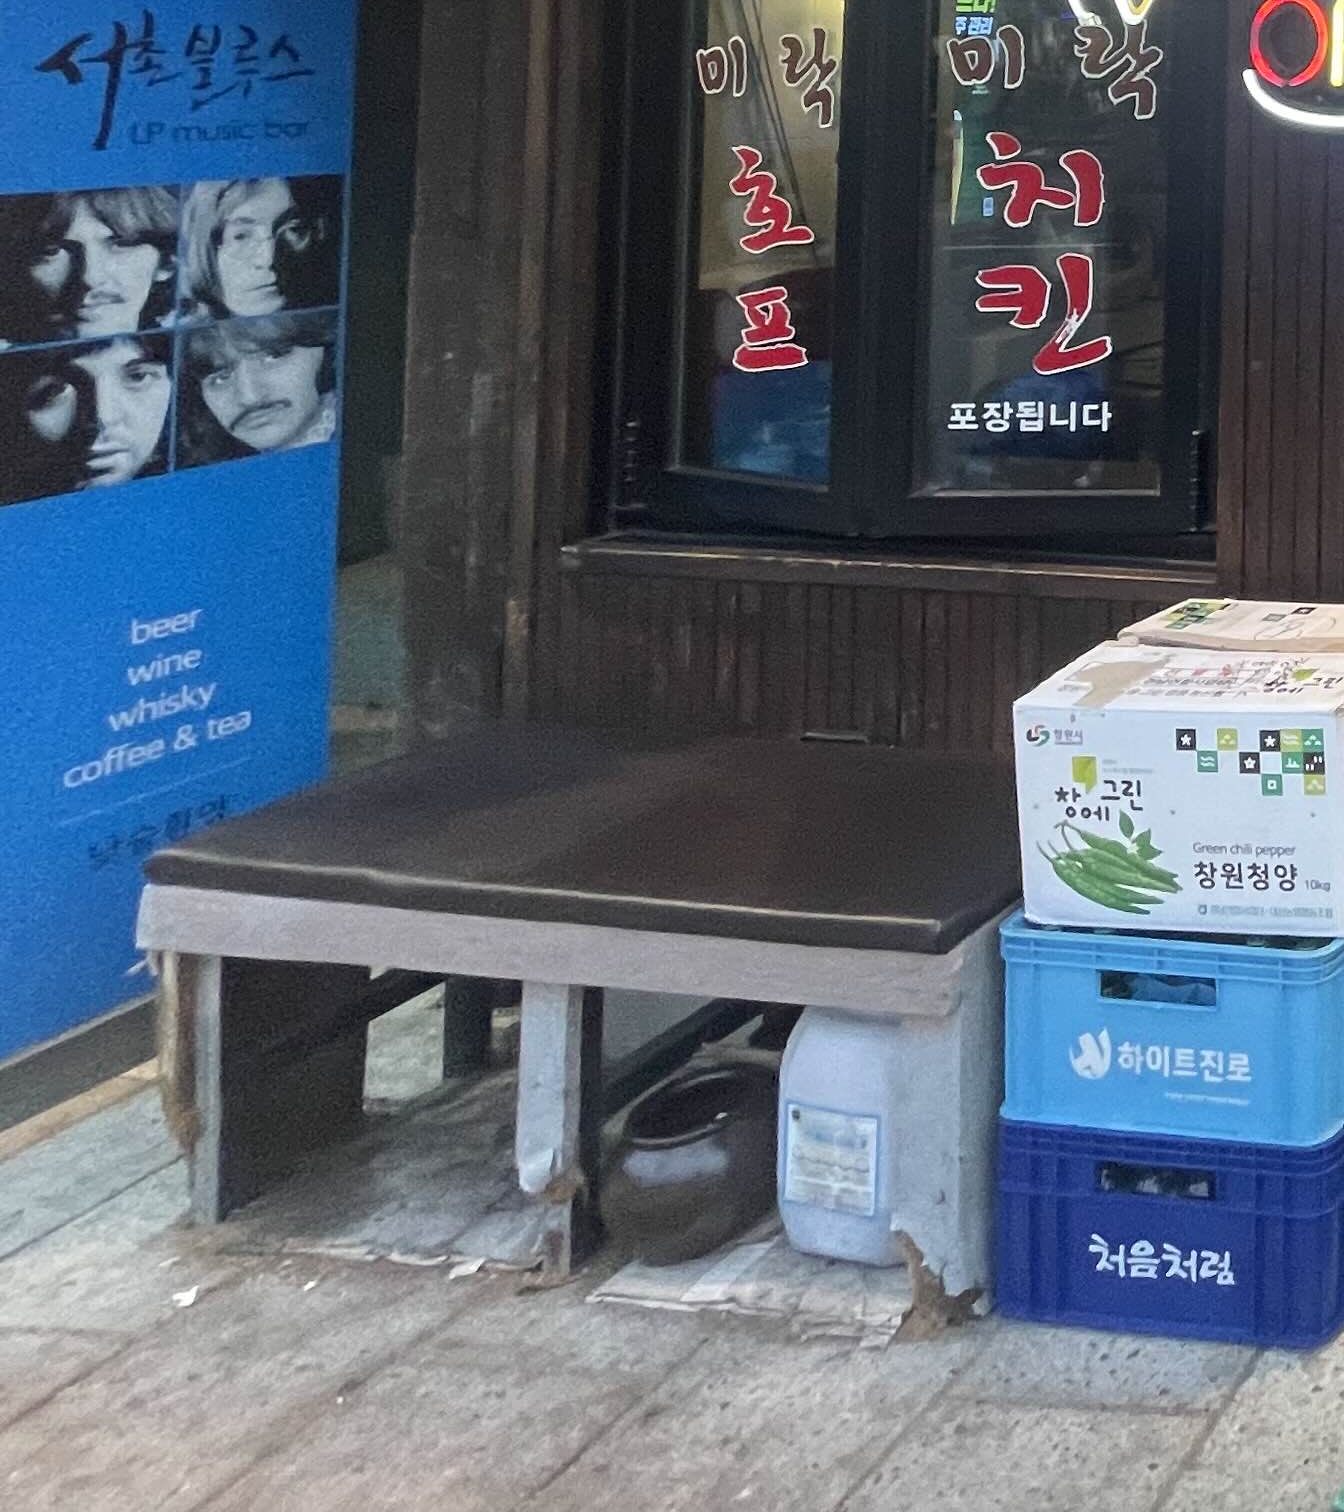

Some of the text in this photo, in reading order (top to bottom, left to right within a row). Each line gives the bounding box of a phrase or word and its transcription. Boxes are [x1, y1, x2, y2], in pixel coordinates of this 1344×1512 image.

[697, 26, 838, 128] 미락
[949, 20, 1164, 119] 미락
[128, 117, 311, 145] LP music bar
[728, 146, 816, 372] 호프
[976, 131, 1113, 375] 치킨
[947, 401, 1113, 434] 포장됩니다
[130, 608, 204, 646] beer
[127, 645, 203, 688] wine
[108, 681, 217, 733] whisky
[62, 708, 253, 790] coffee & tea
[1192, 841, 1297, 858] Green chili pepper
[1193, 861, 1331, 892] 창원청양 10kg
[1117, 1039, 1252, 1083] 하이트진로
[1088, 1233, 1235, 1286] 처음처럼
